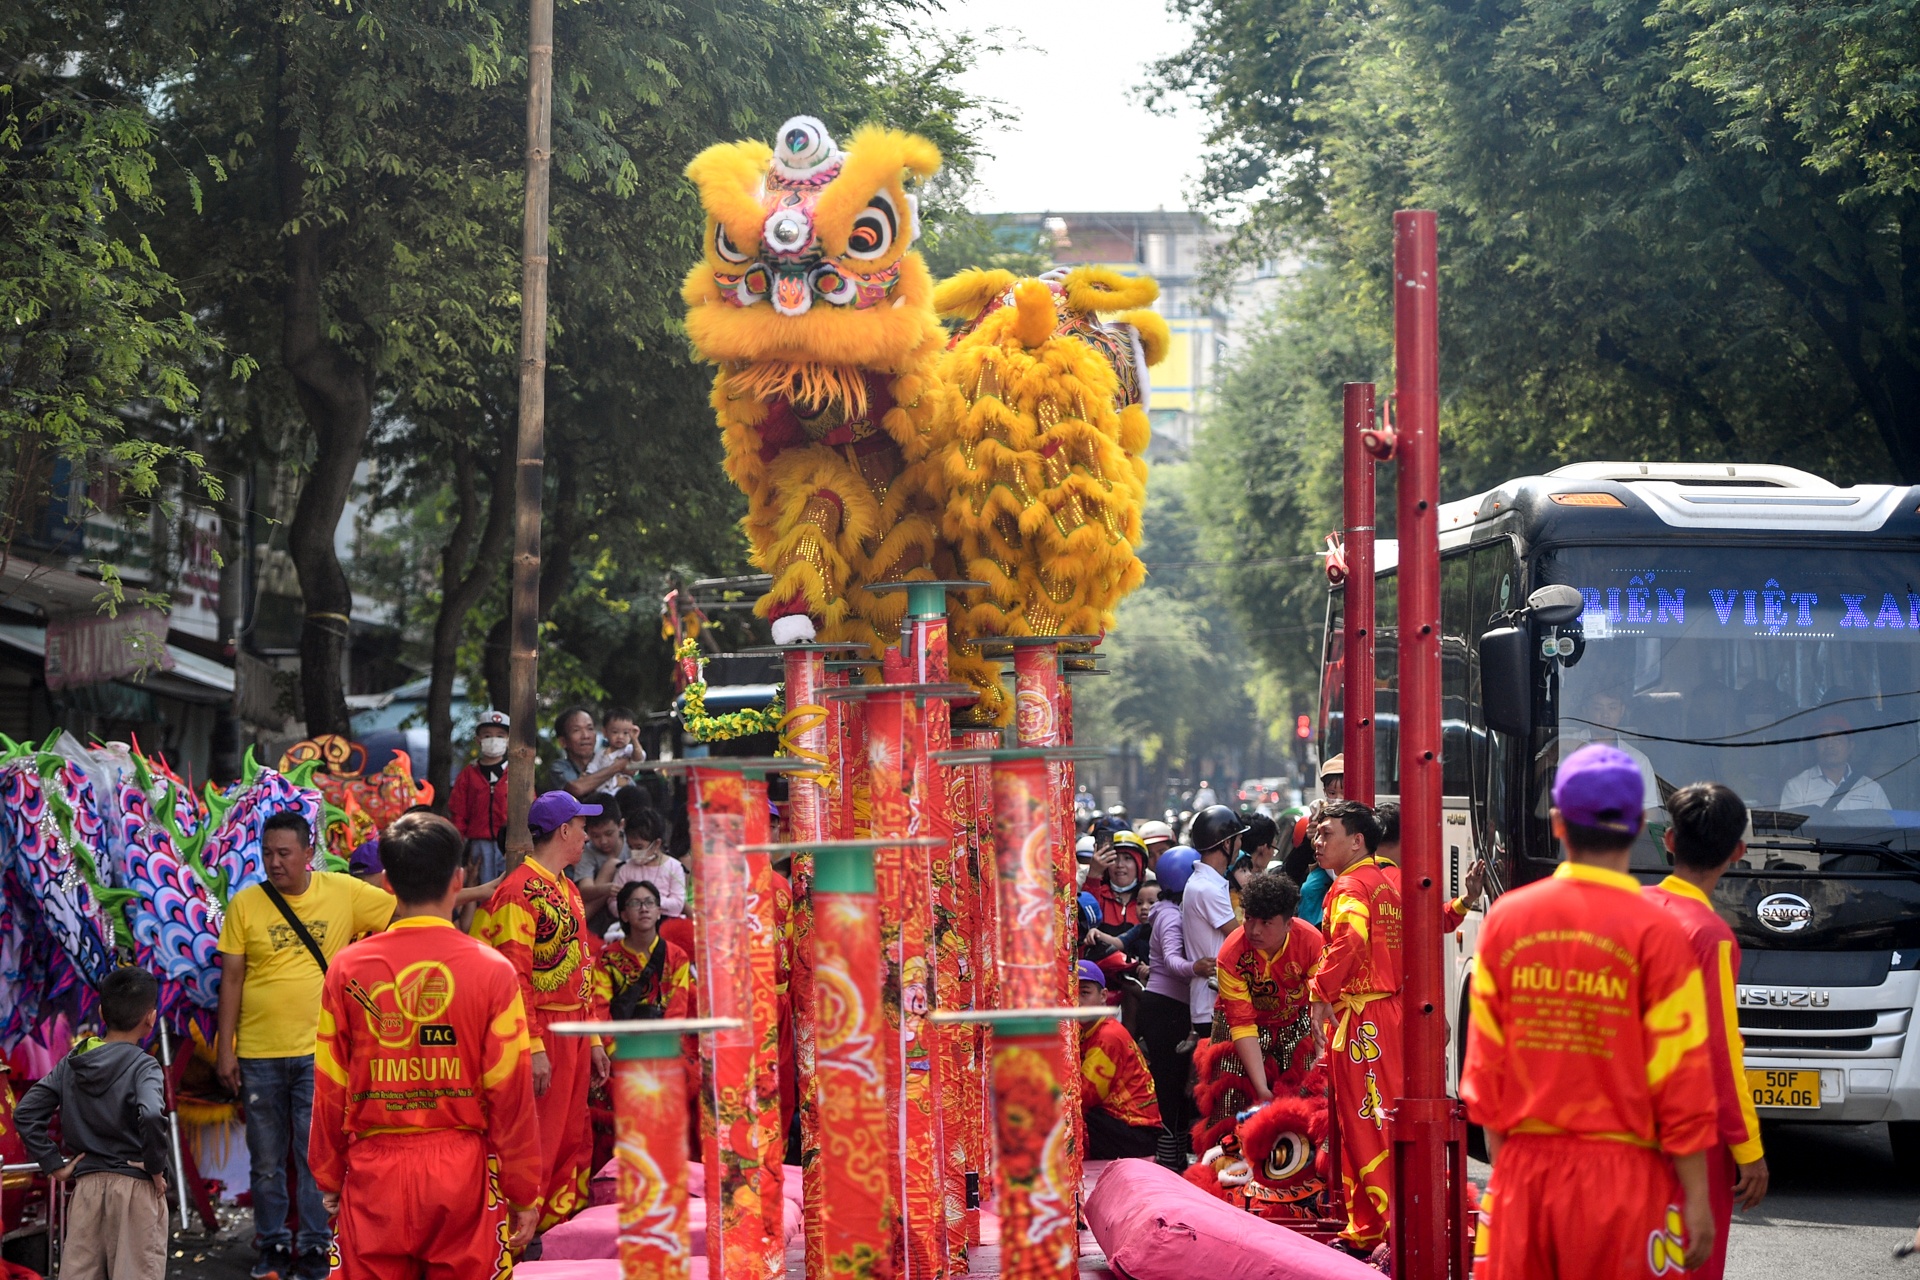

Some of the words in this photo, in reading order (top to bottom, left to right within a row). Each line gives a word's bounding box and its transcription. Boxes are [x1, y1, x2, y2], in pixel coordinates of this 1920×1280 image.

[1708, 577, 1819, 634] VIỆT
[1762, 907, 1808, 919] SAMCO
[1511, 962, 1562, 991] HỮU
[1564, 965, 1629, 1000] CHẤN
[1739, 987, 1830, 1008] ISUZU
[424, 1029, 453, 1042] TAC
[1766, 1071, 1798, 1088] 50F
[1752, 1089, 1813, 1106] 034.06
